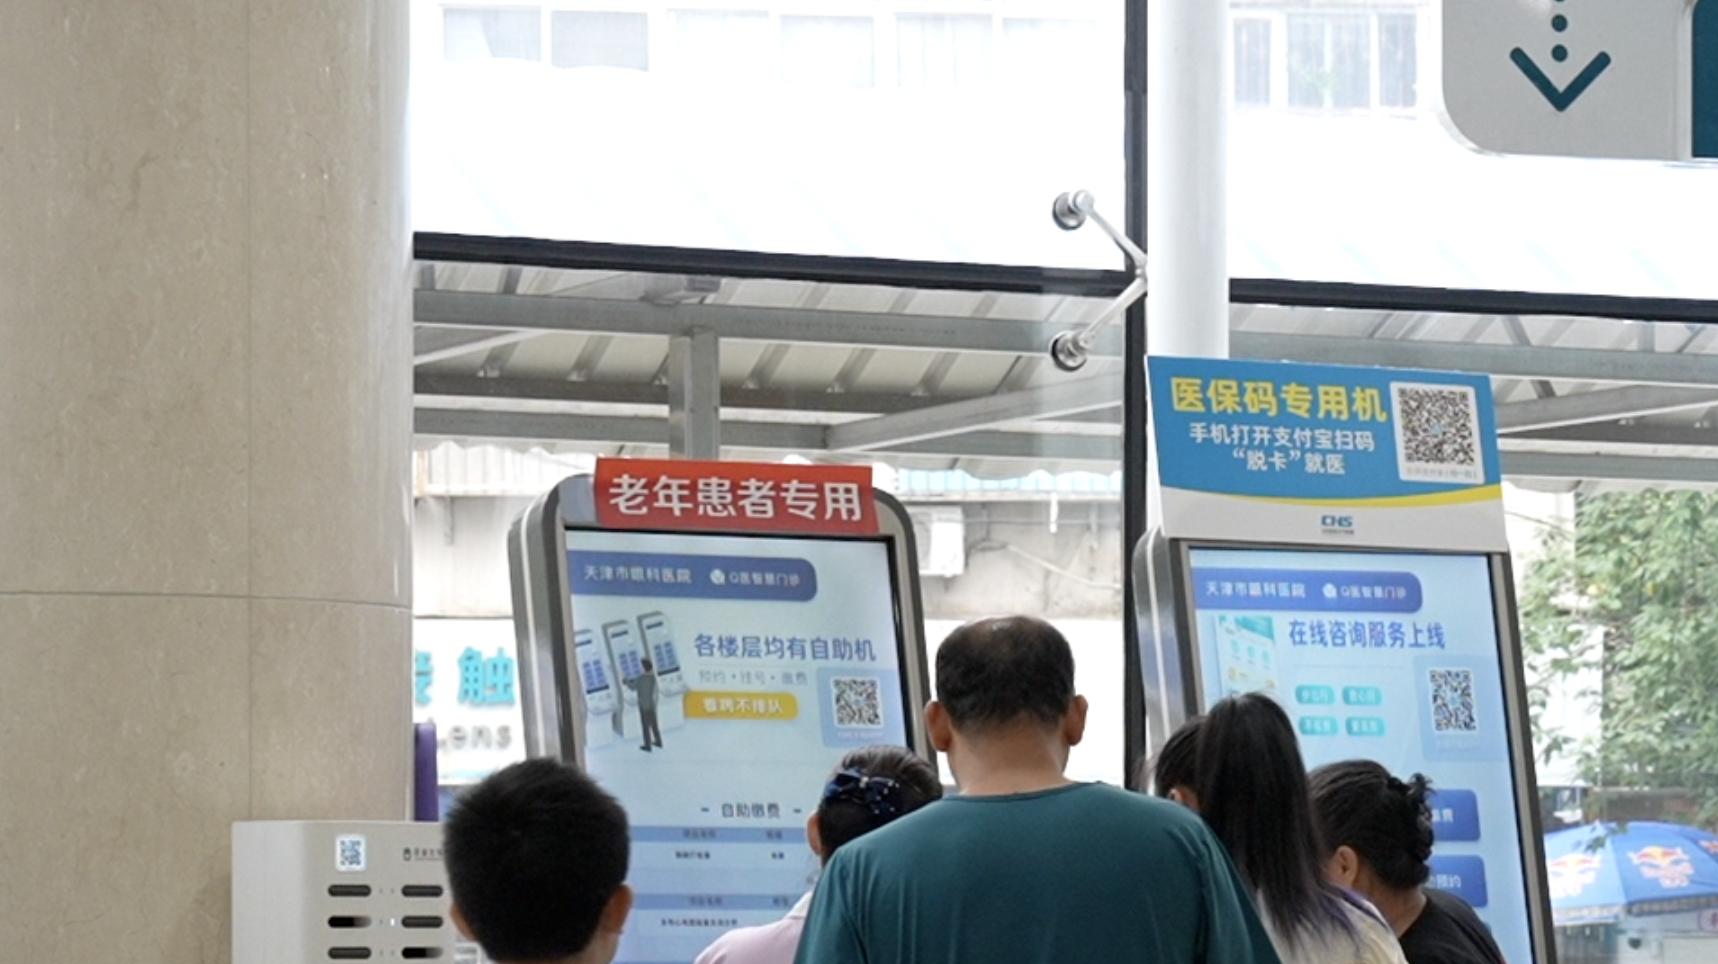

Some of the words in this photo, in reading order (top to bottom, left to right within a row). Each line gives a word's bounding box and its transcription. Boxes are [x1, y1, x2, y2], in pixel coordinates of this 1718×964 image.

[1171, 377, 1388, 422] 医保码专用机
[1190, 422, 1375, 452] 手机打开支付宝扫码
[608, 473, 863, 522] 老年患者专用
[584, 564, 692, 584] 天津市眼科医院
[1206, 581, 1305, 598] 天津市眼科医院
[694, 633, 876, 662] 各楼层均有自助机
[1289, 620, 1445, 649] 在线咨询服务上线
[703, 697, 783, 715] 看病不排队
[722, 803, 780, 818] 自助缴费
